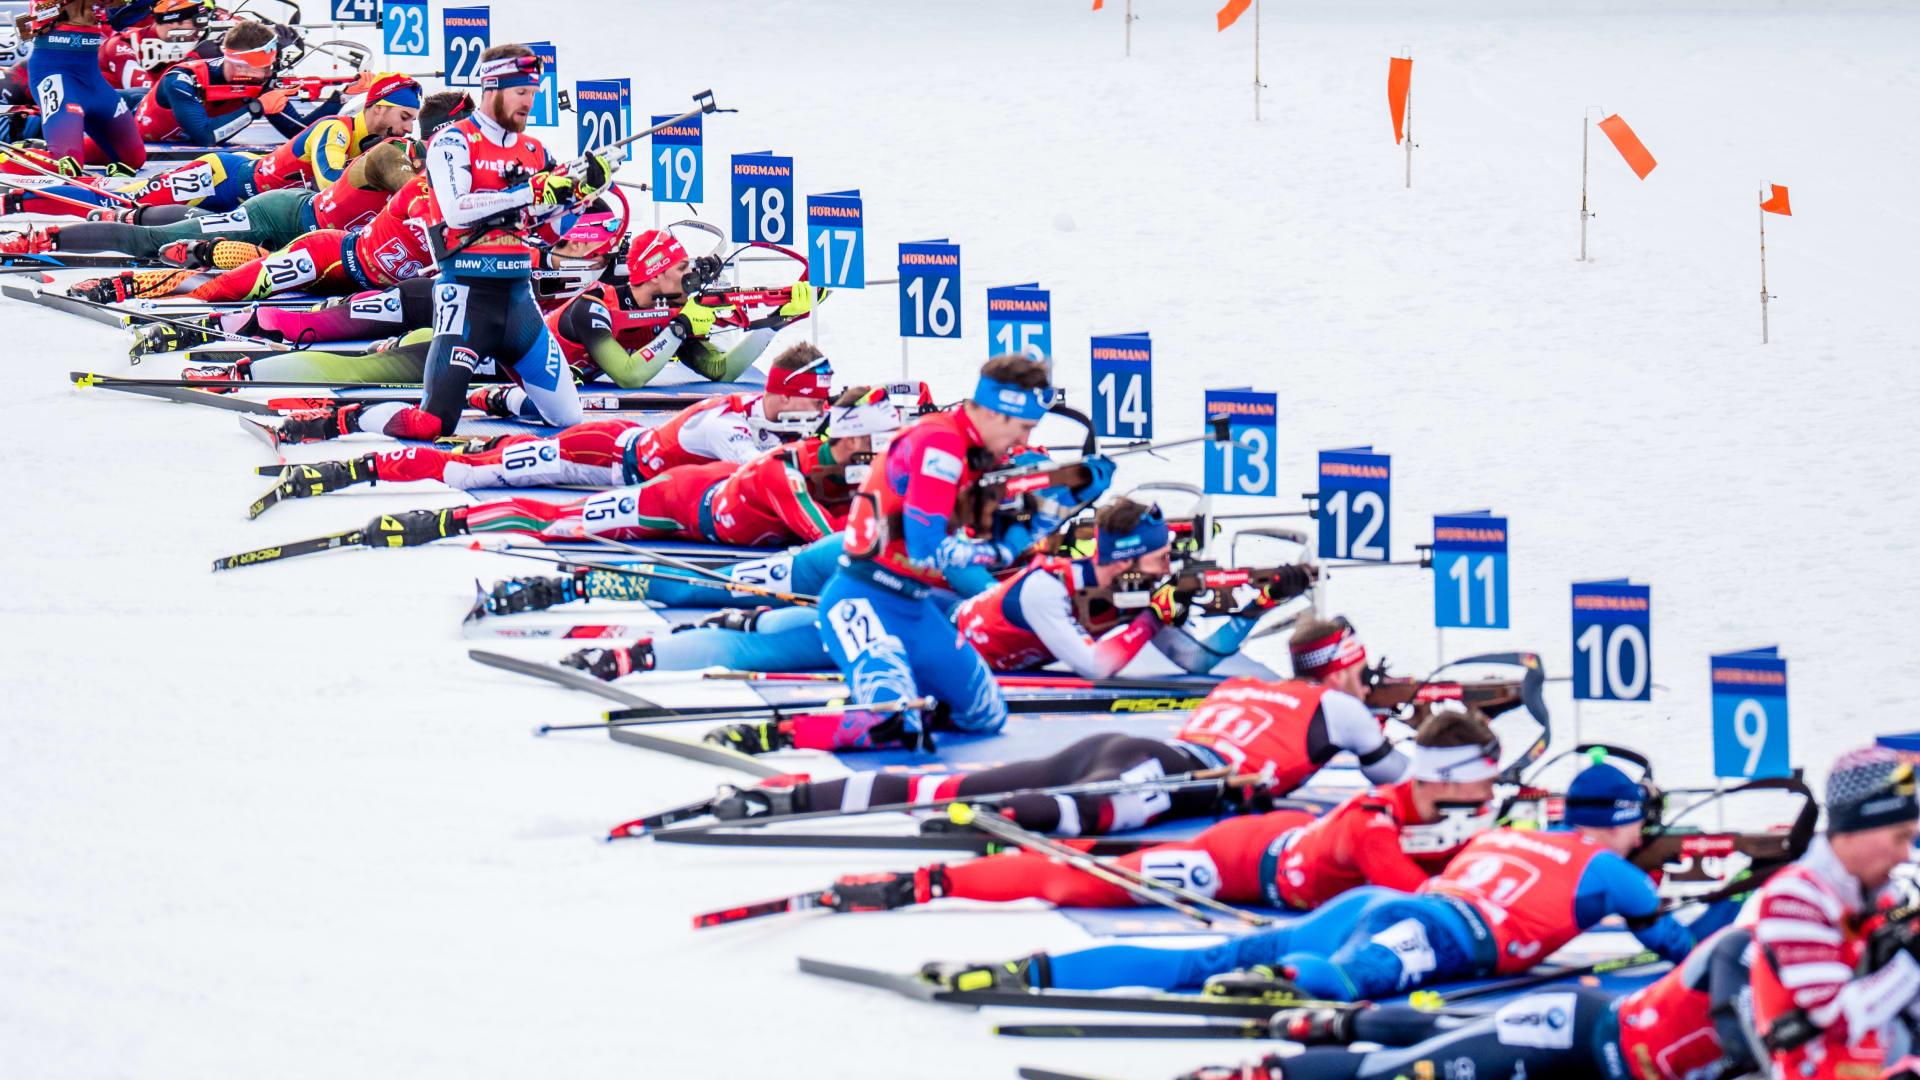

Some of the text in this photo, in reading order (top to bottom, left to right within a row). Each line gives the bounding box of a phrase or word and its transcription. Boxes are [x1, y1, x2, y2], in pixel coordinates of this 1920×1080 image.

[48, 35, 70, 44] BMW
[388, 6, 424, 53] 23
[450, 36, 484, 85] 22
[582, 110, 616, 156] 20
[172, 173, 201, 195] 22
[658, 147, 697, 200] 19
[740, 187, 786, 243] 18
[265, 259, 299, 285] 20
[455, 259, 481, 269] BMW
[815, 229, 857, 285] 17
[437, 303, 459, 333] 17
[628, 311, 669, 319] KOLEKTOR
[906, 276, 956, 336] 16
[996, 322, 1044, 362] 15
[1097, 372, 1148, 436] 14
[505, 445, 537, 470] 16
[1214, 427, 1270, 494] 13
[585, 496, 616, 521] 15
[1325, 490, 1385, 560] 12
[1449, 555, 1496, 625] 11
[847, 615, 877, 651] 12
[1575, 624, 1649, 700] 10
[1733, 698, 1768, 777] 9
